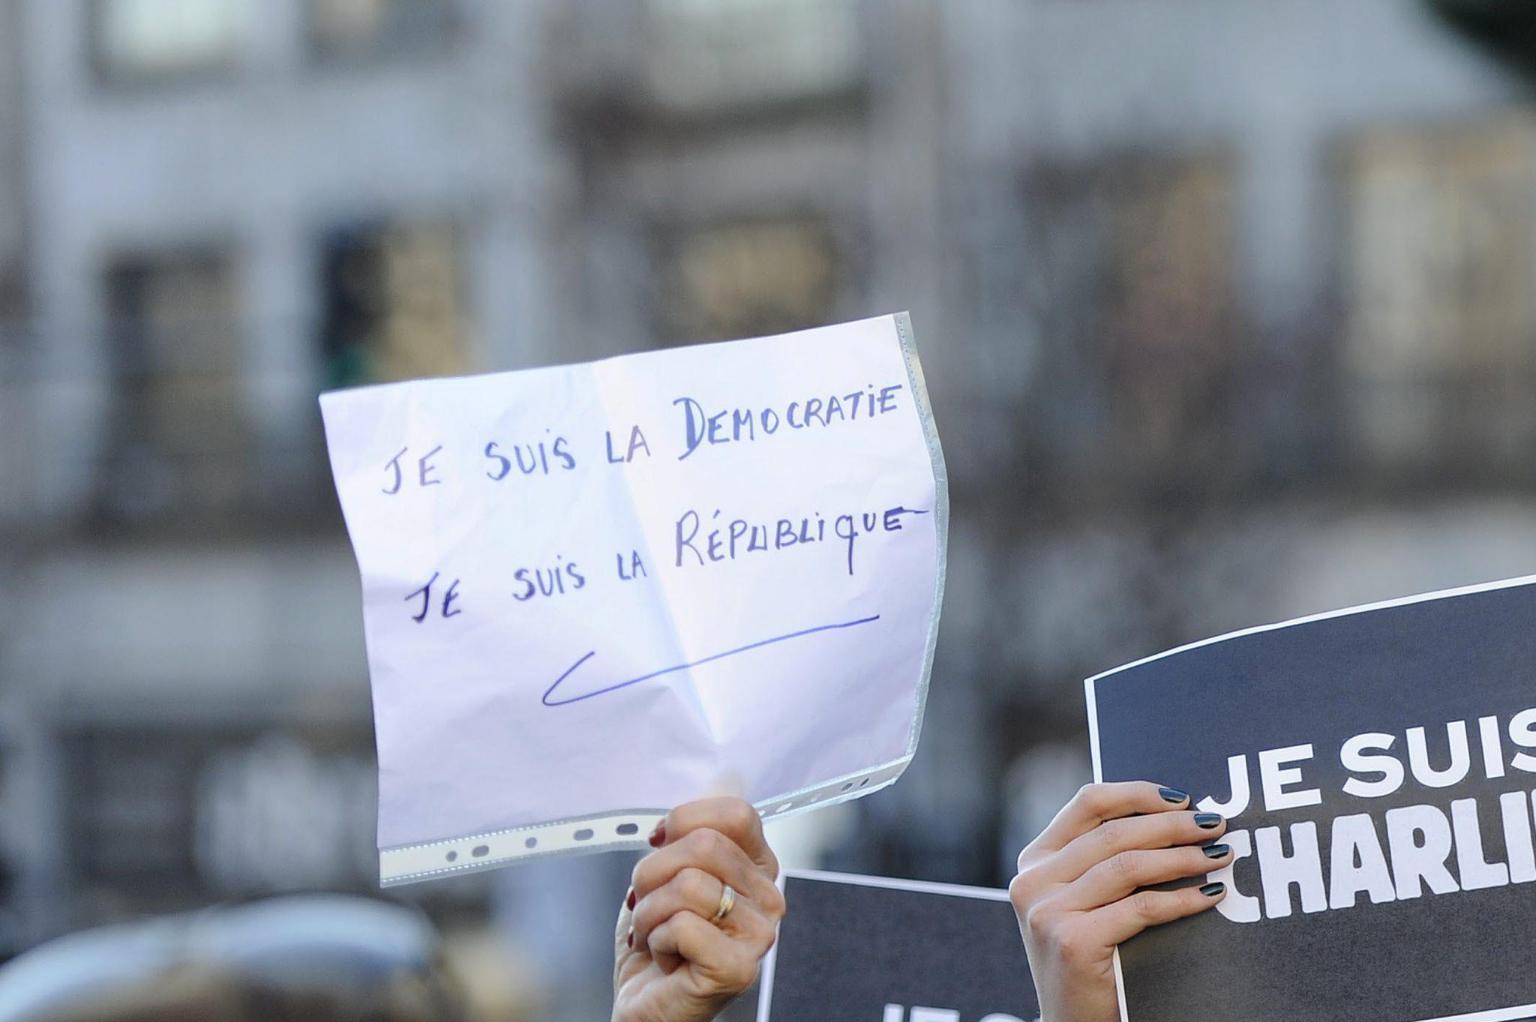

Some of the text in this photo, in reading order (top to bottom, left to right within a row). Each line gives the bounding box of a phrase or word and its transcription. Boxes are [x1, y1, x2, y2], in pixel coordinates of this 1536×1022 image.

[381, 445, 443, 495] JE
[484, 428, 576, 481] SUIS
[606, 425, 651, 464] LA
[404, 571, 461, 623] JE
[512, 555, 585, 601] SUIS
[617, 549, 647, 580] LA
[1196, 743, 1322, 819] JE
